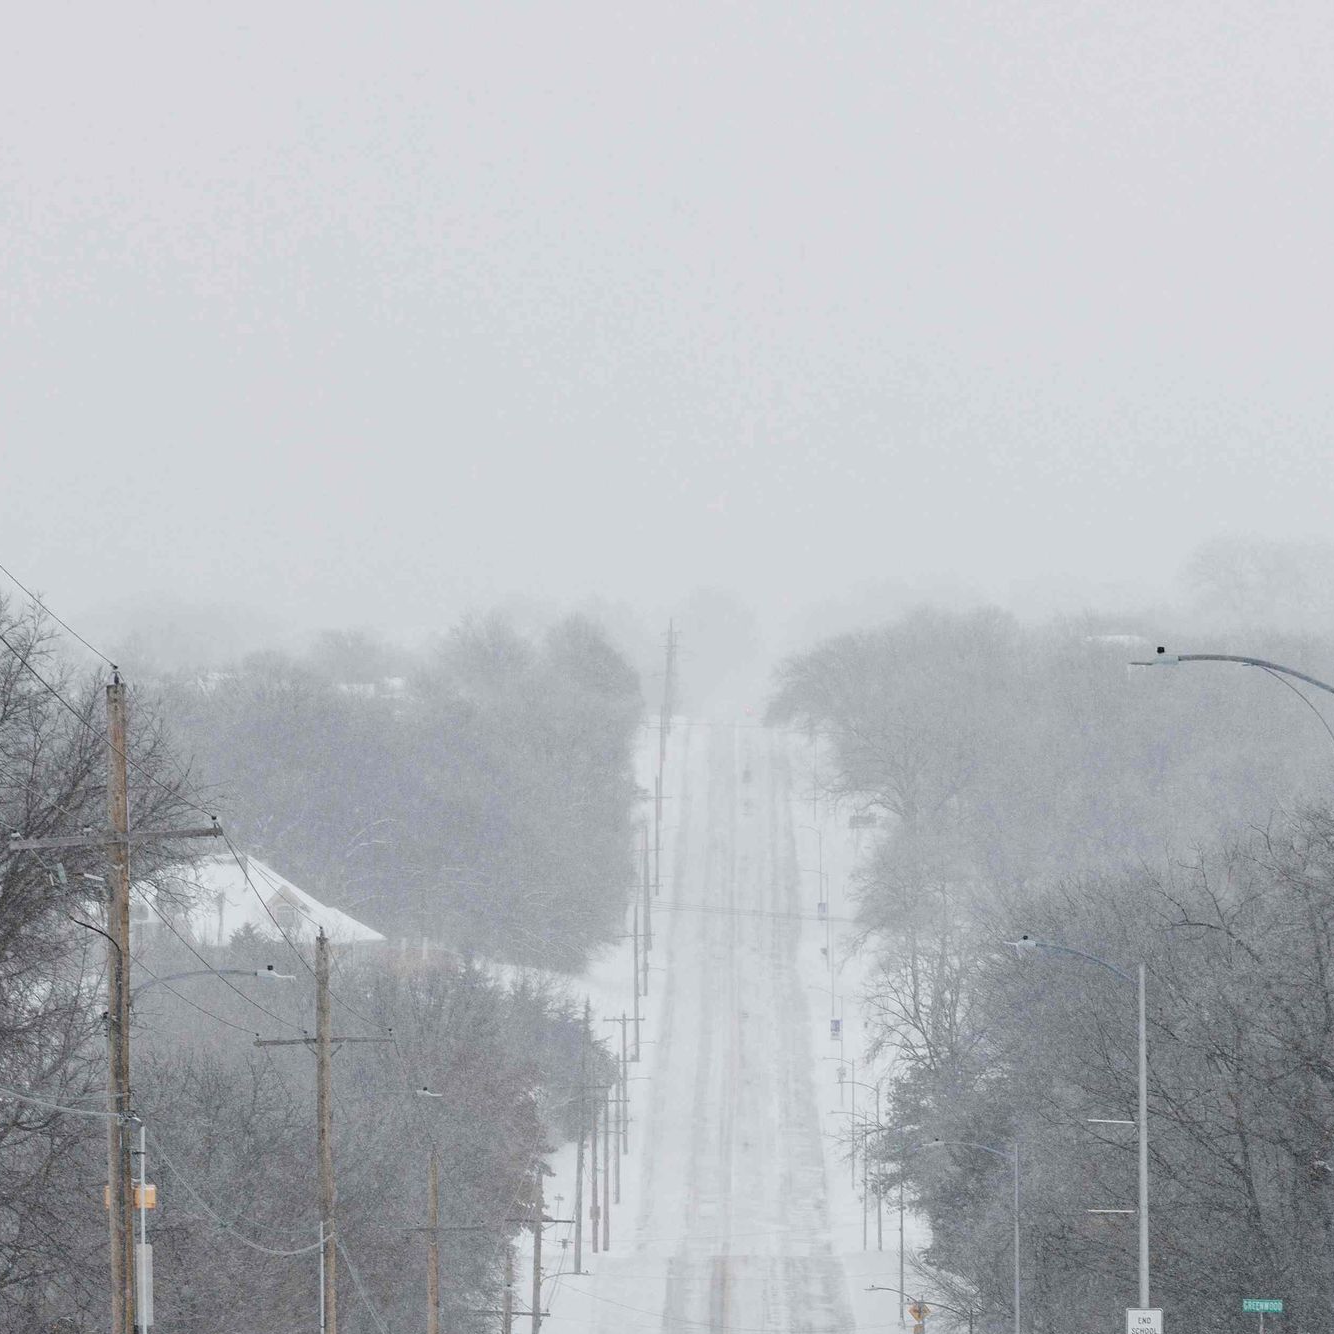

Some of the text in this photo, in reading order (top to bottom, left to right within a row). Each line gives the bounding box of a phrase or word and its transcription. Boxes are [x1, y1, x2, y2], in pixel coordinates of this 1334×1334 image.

[1243, 1301, 1282, 1311] GREENWOOD
[1138, 1317, 1152, 1325] END
[1130, 1327, 1157, 1334] SCHOOL
